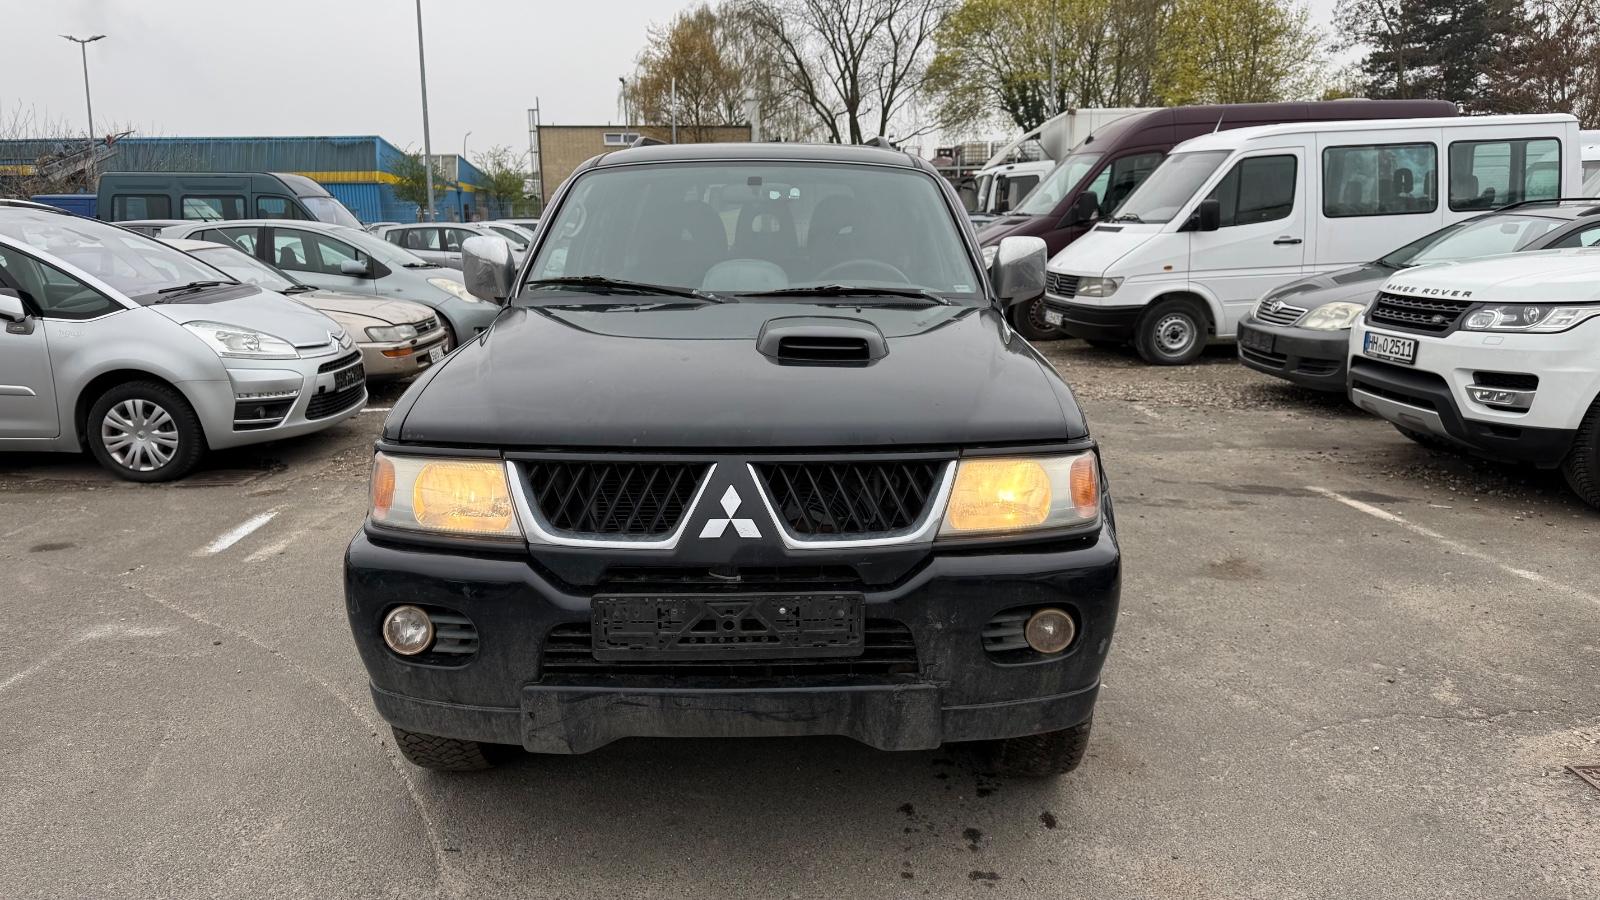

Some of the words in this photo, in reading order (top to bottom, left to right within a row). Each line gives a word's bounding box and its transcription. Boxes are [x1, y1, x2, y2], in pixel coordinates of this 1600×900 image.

[1387, 284, 1417, 293] RANGE
[1421, 288, 1473, 297] ROVER
[1389, 339, 1412, 357] 2511
